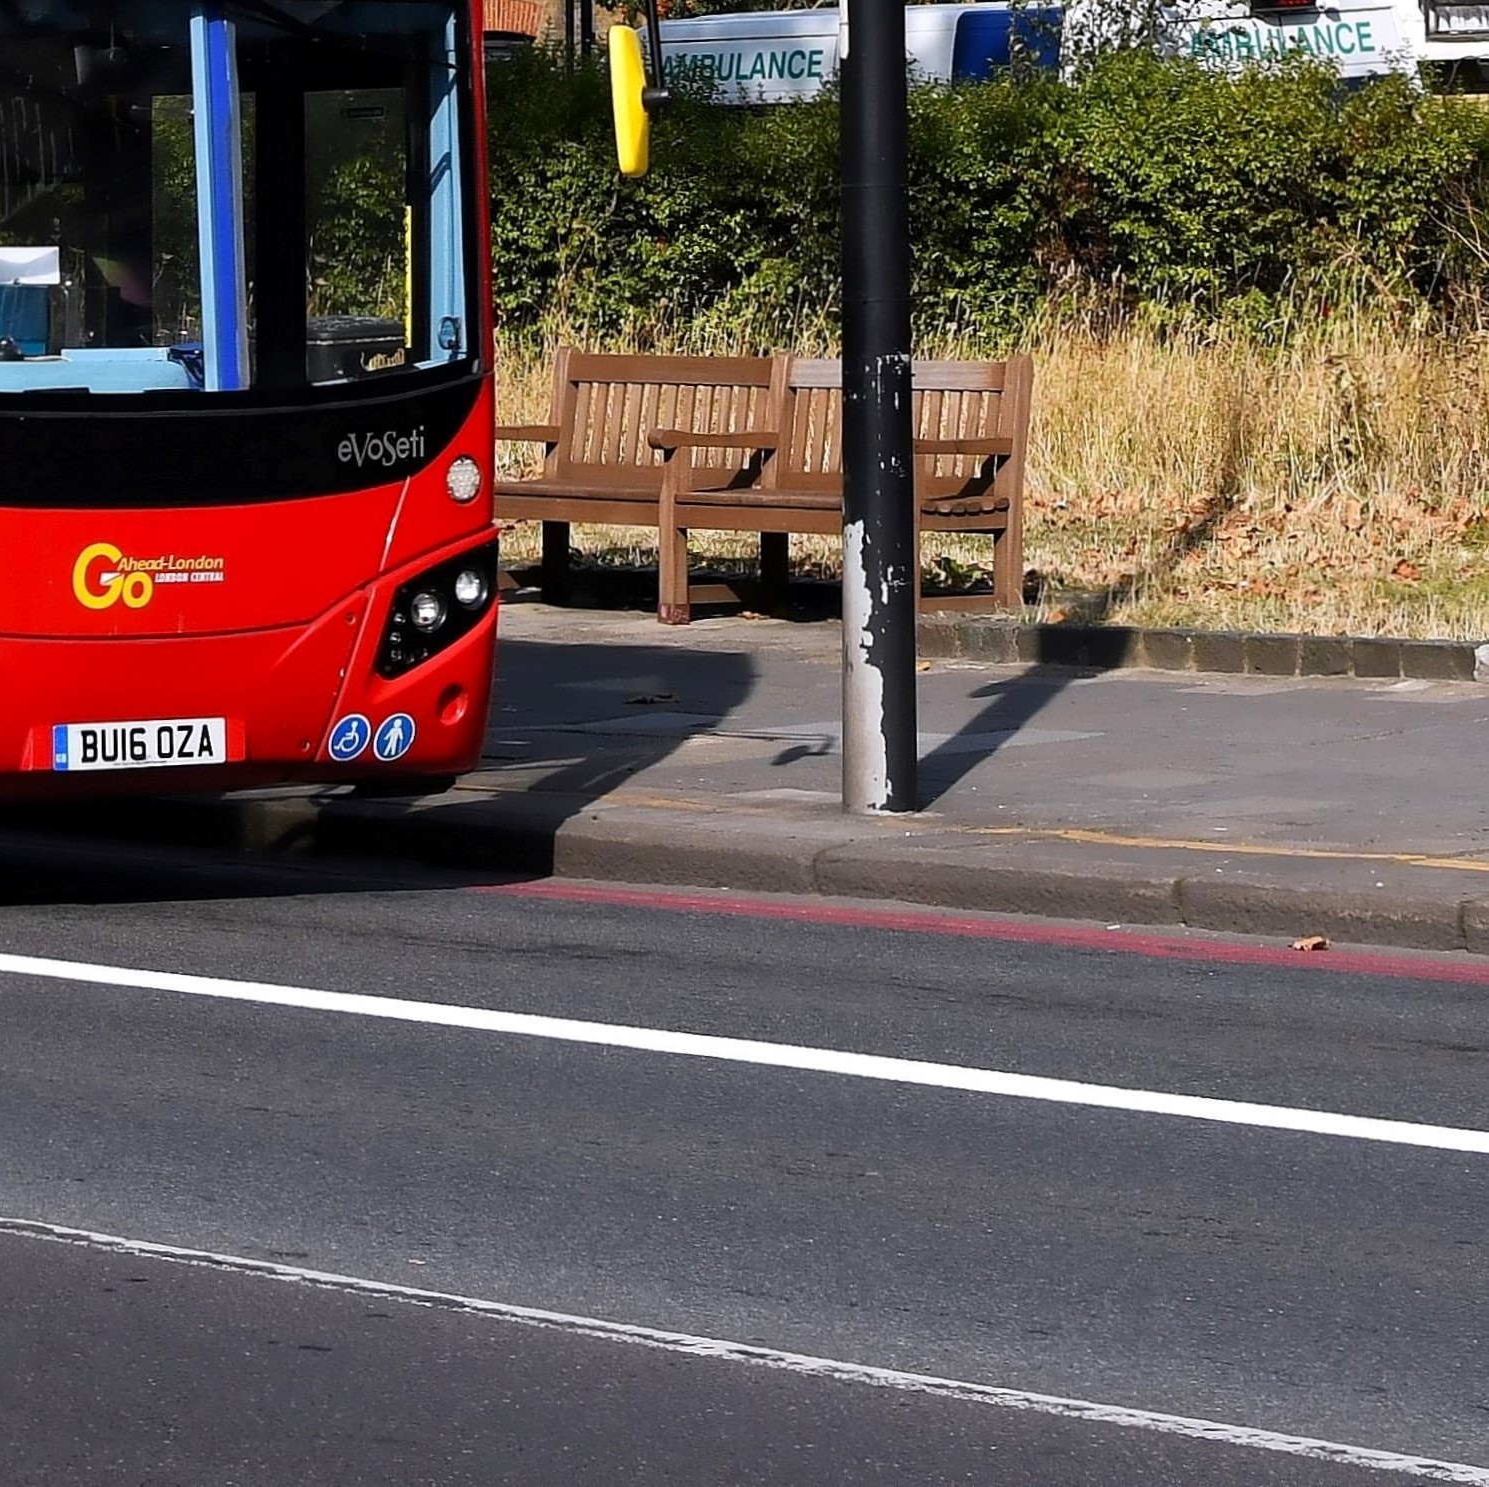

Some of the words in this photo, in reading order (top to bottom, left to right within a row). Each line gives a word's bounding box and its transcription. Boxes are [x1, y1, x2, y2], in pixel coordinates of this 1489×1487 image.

[337, 425, 425, 467] eVoSeti
[73, 542, 153, 609] Go
[80, 727, 147, 764] BU16
[157, 724, 214, 759] OZA
